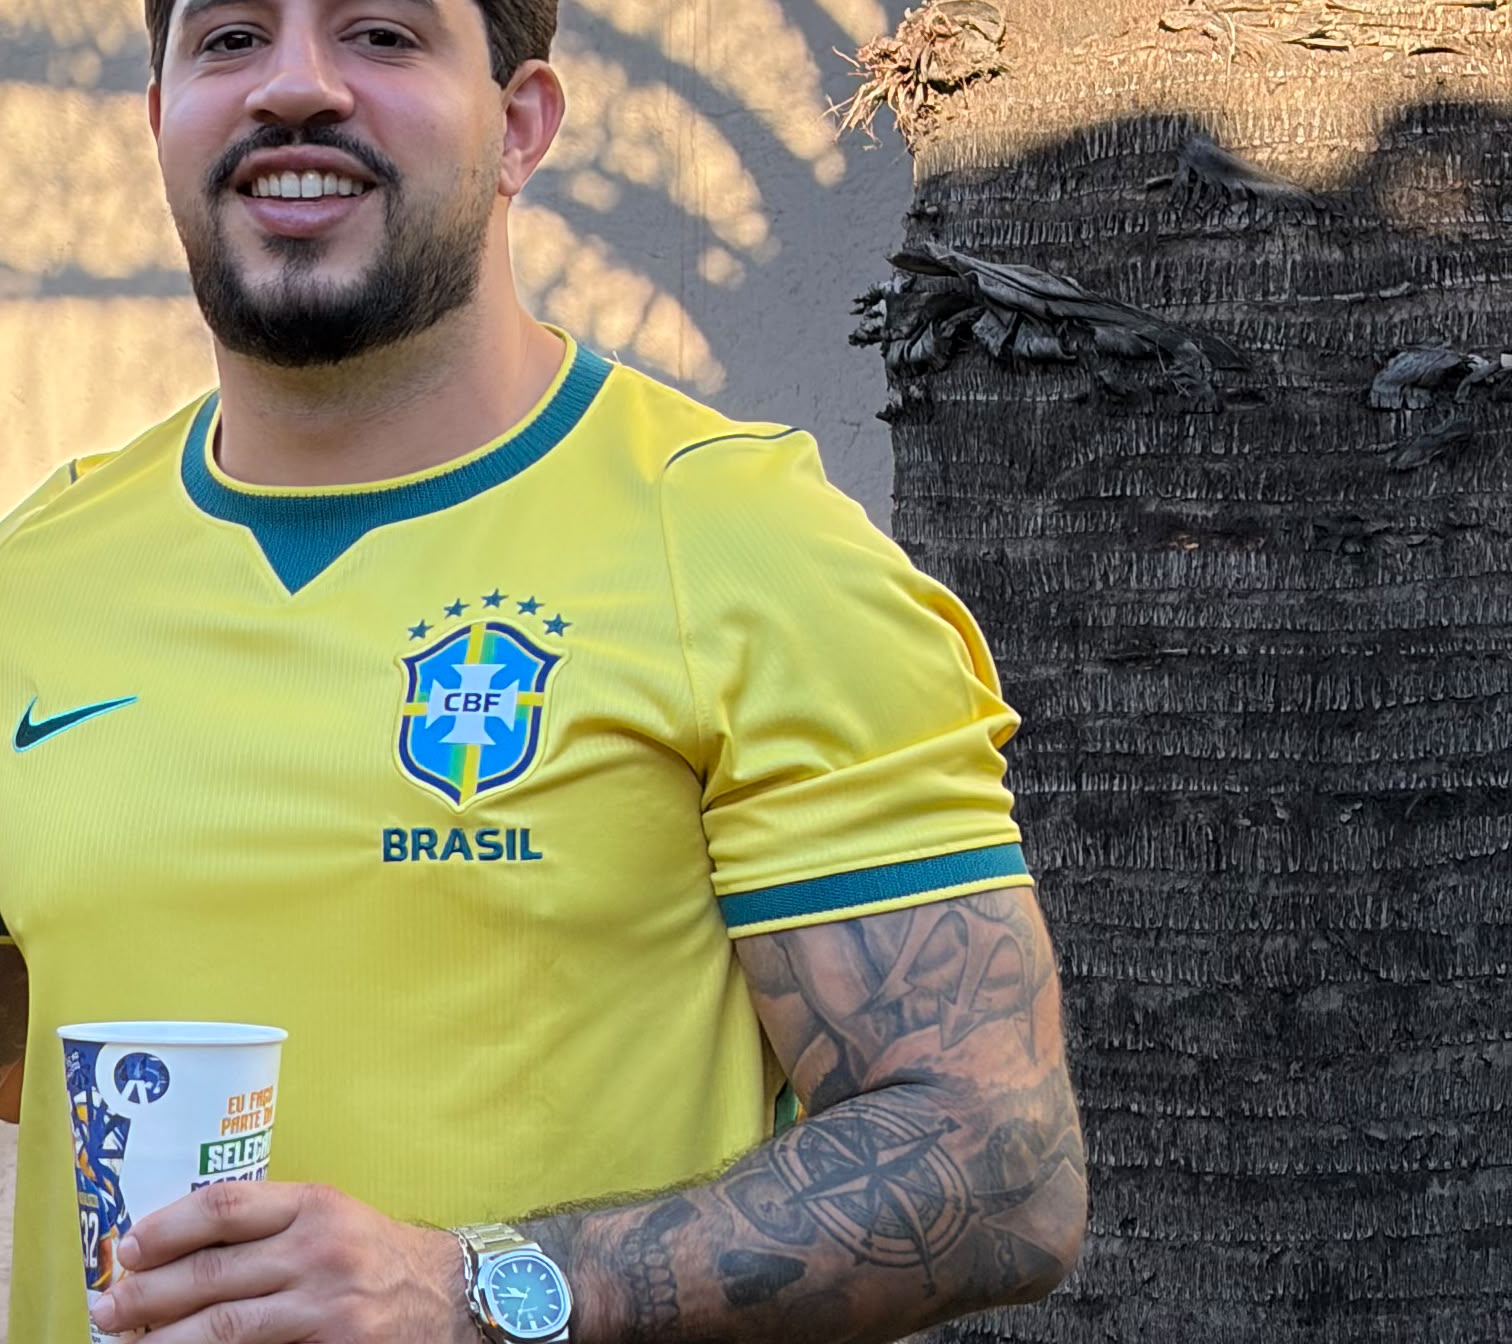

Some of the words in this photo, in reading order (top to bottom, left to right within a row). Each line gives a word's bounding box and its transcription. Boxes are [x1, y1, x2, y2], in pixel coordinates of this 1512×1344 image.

[444, 692, 502, 713] CBF
[382, 827, 543, 863] BRASIL
[227, 1094, 246, 1115] EU
[221, 1111, 261, 1136] PARTE
